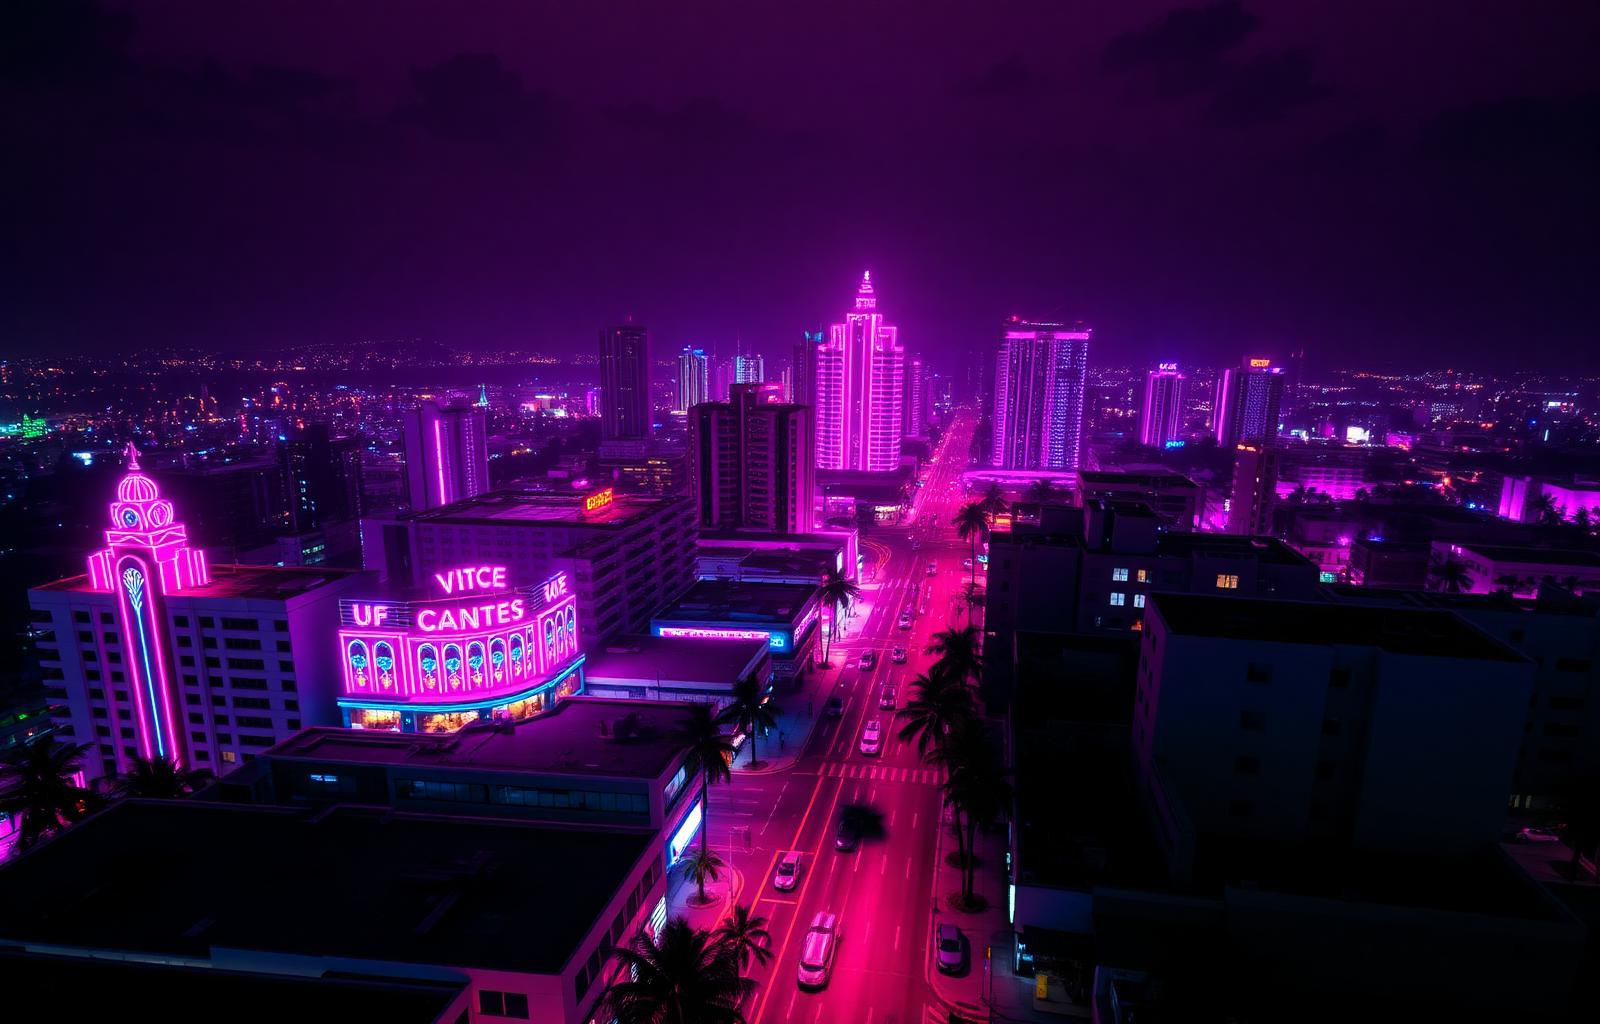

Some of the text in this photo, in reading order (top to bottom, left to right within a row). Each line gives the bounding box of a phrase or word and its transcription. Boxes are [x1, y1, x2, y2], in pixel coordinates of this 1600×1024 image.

[436, 566, 507, 594] VITCE
[353, 604, 388, 626] UF
[417, 599, 525, 631] CANTES
